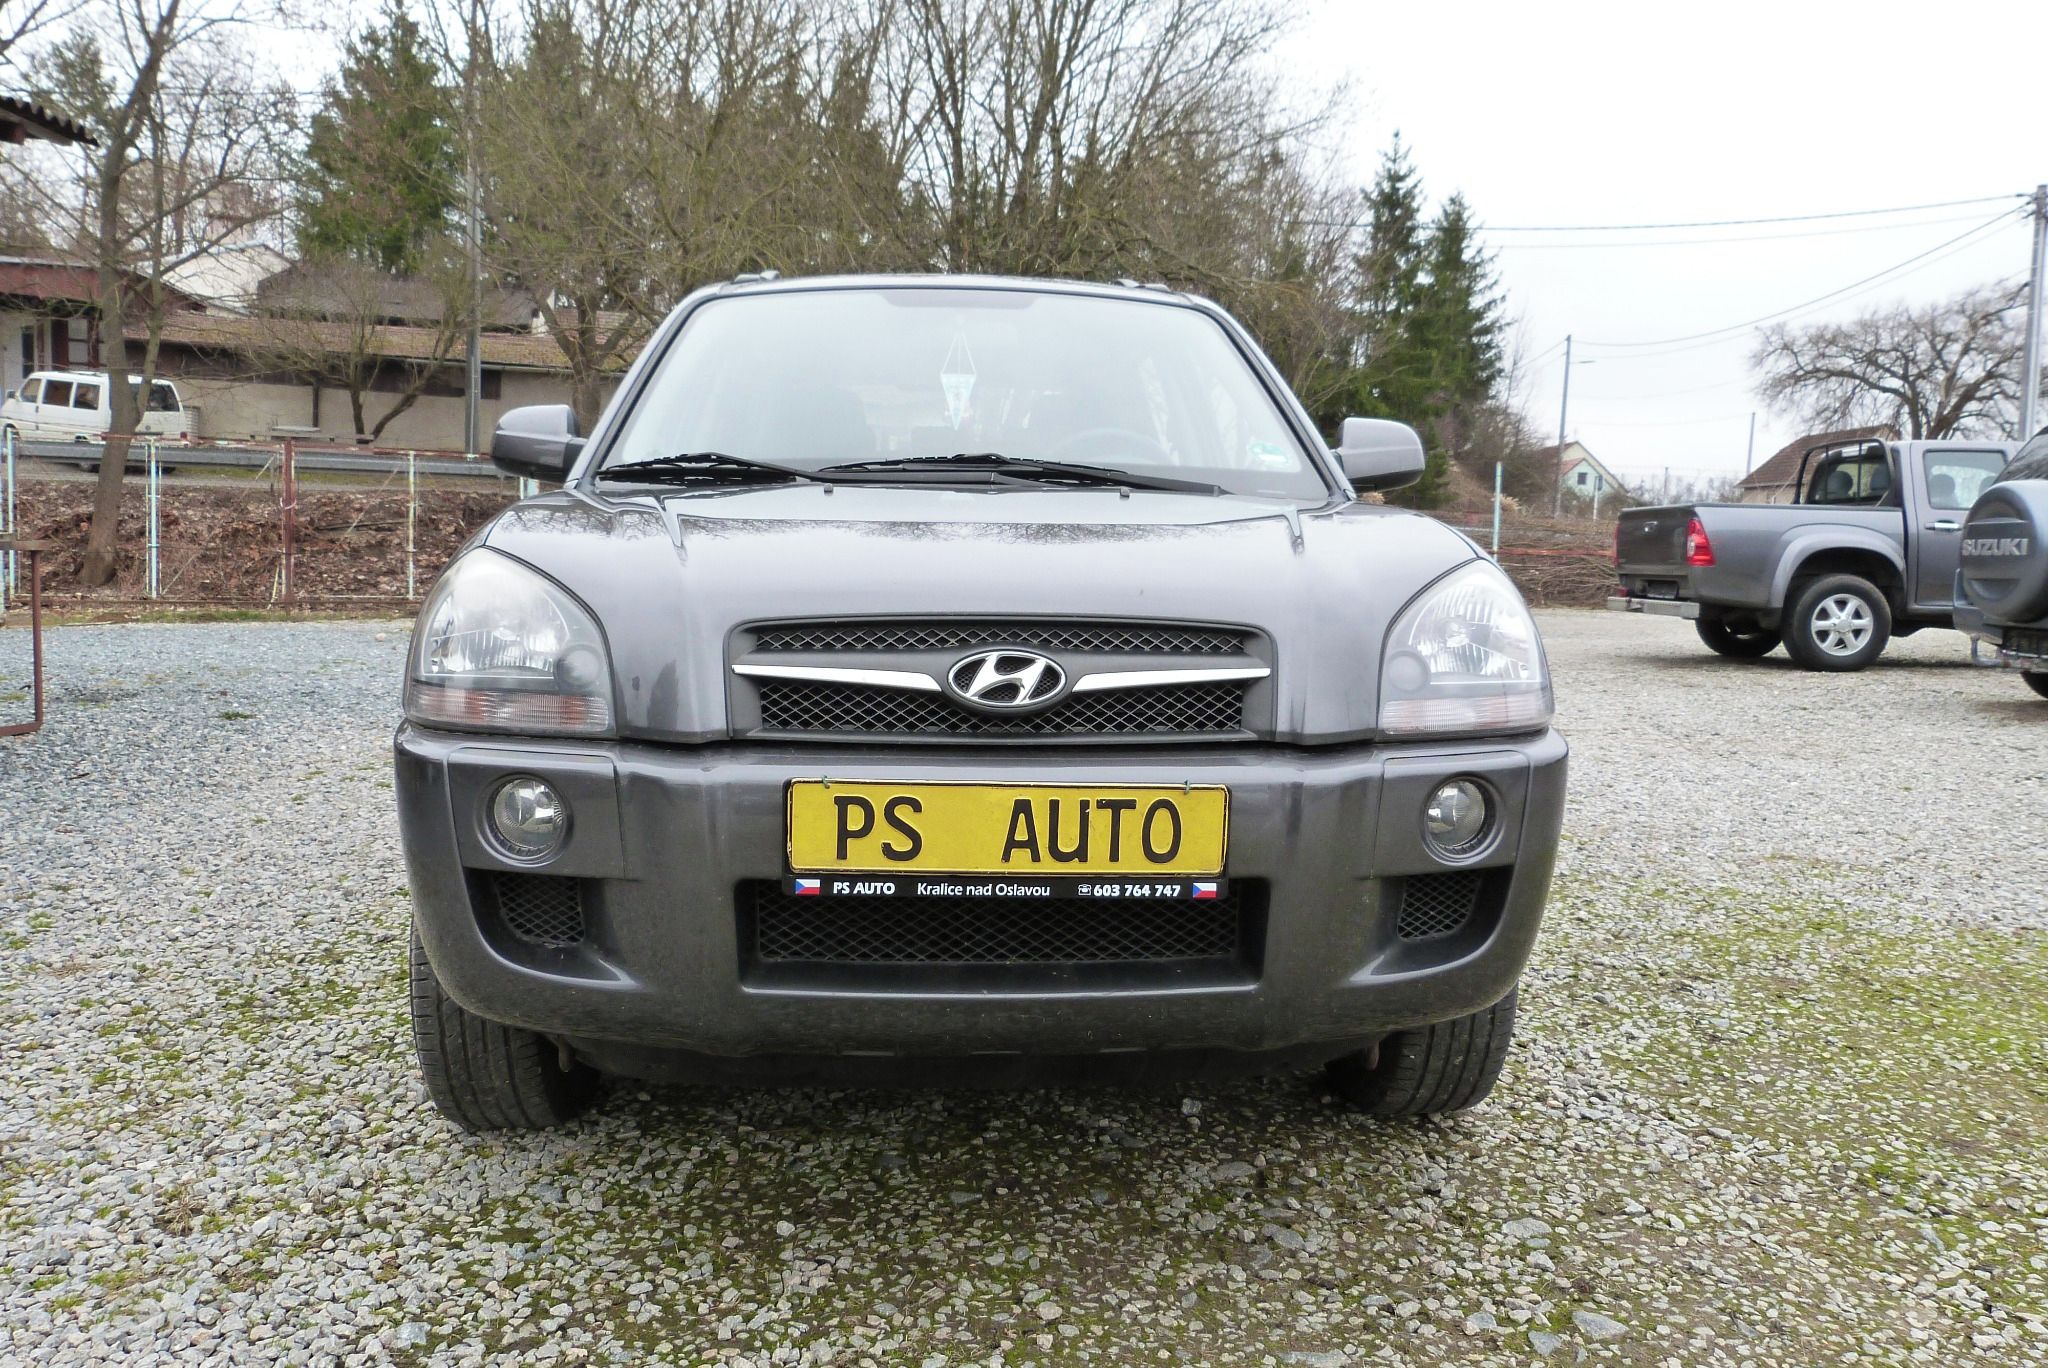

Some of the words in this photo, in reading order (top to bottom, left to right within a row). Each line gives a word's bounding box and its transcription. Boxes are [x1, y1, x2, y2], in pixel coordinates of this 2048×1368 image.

[1962, 538, 2029, 556] SUZUKI
[833, 795, 923, 862] PS
[1001, 798, 1182, 863] AUTO
[833, 881, 850, 895] PS
[853, 881, 896, 895] AUTO
[917, 882, 963, 896] Kralice
[966, 883, 992, 896] nad
[995, 884, 1051, 897] Oslavou
[1093, 884, 1120, 897] 603
[1124, 884, 1151, 897] 764
[1154, 884, 1181, 897] 747
